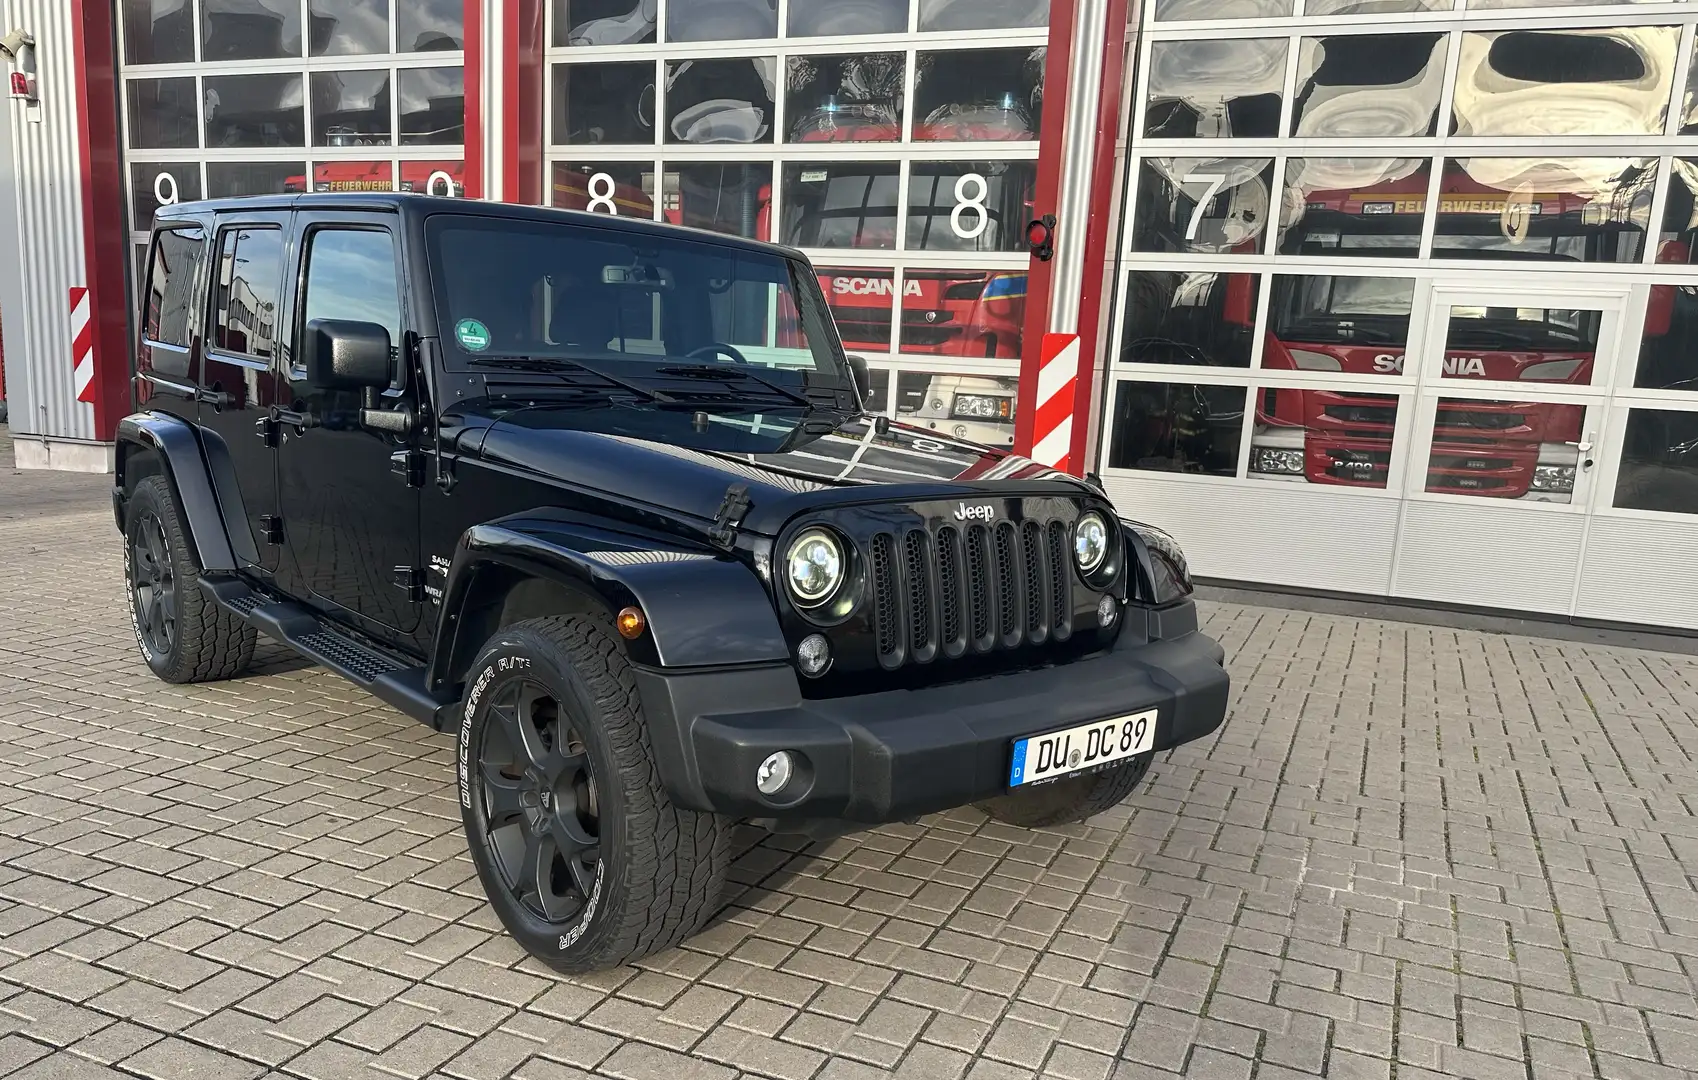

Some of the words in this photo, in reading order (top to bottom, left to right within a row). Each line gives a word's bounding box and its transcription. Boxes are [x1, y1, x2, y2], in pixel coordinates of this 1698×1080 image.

[330, 181, 392, 191] FEUERWEHR
[586, 172, 617, 215] 8
[950, 173, 988, 238] 8
[1183, 174, 1226, 239] 7
[1394, 200, 1507, 213] FEURWEHR
[469, 323, 477, 335] 4
[1373, 354, 1486, 376] SNIA
[954, 502, 994, 522] Jeep
[459, 665, 496, 809] DISCOVERER
[1035, 735, 1070, 774] DU
[1084, 725, 1116, 762] DC
[1120, 718, 1147, 752] 89
[1014, 768, 1021, 778] D
[559, 858, 605, 950] COOPER
